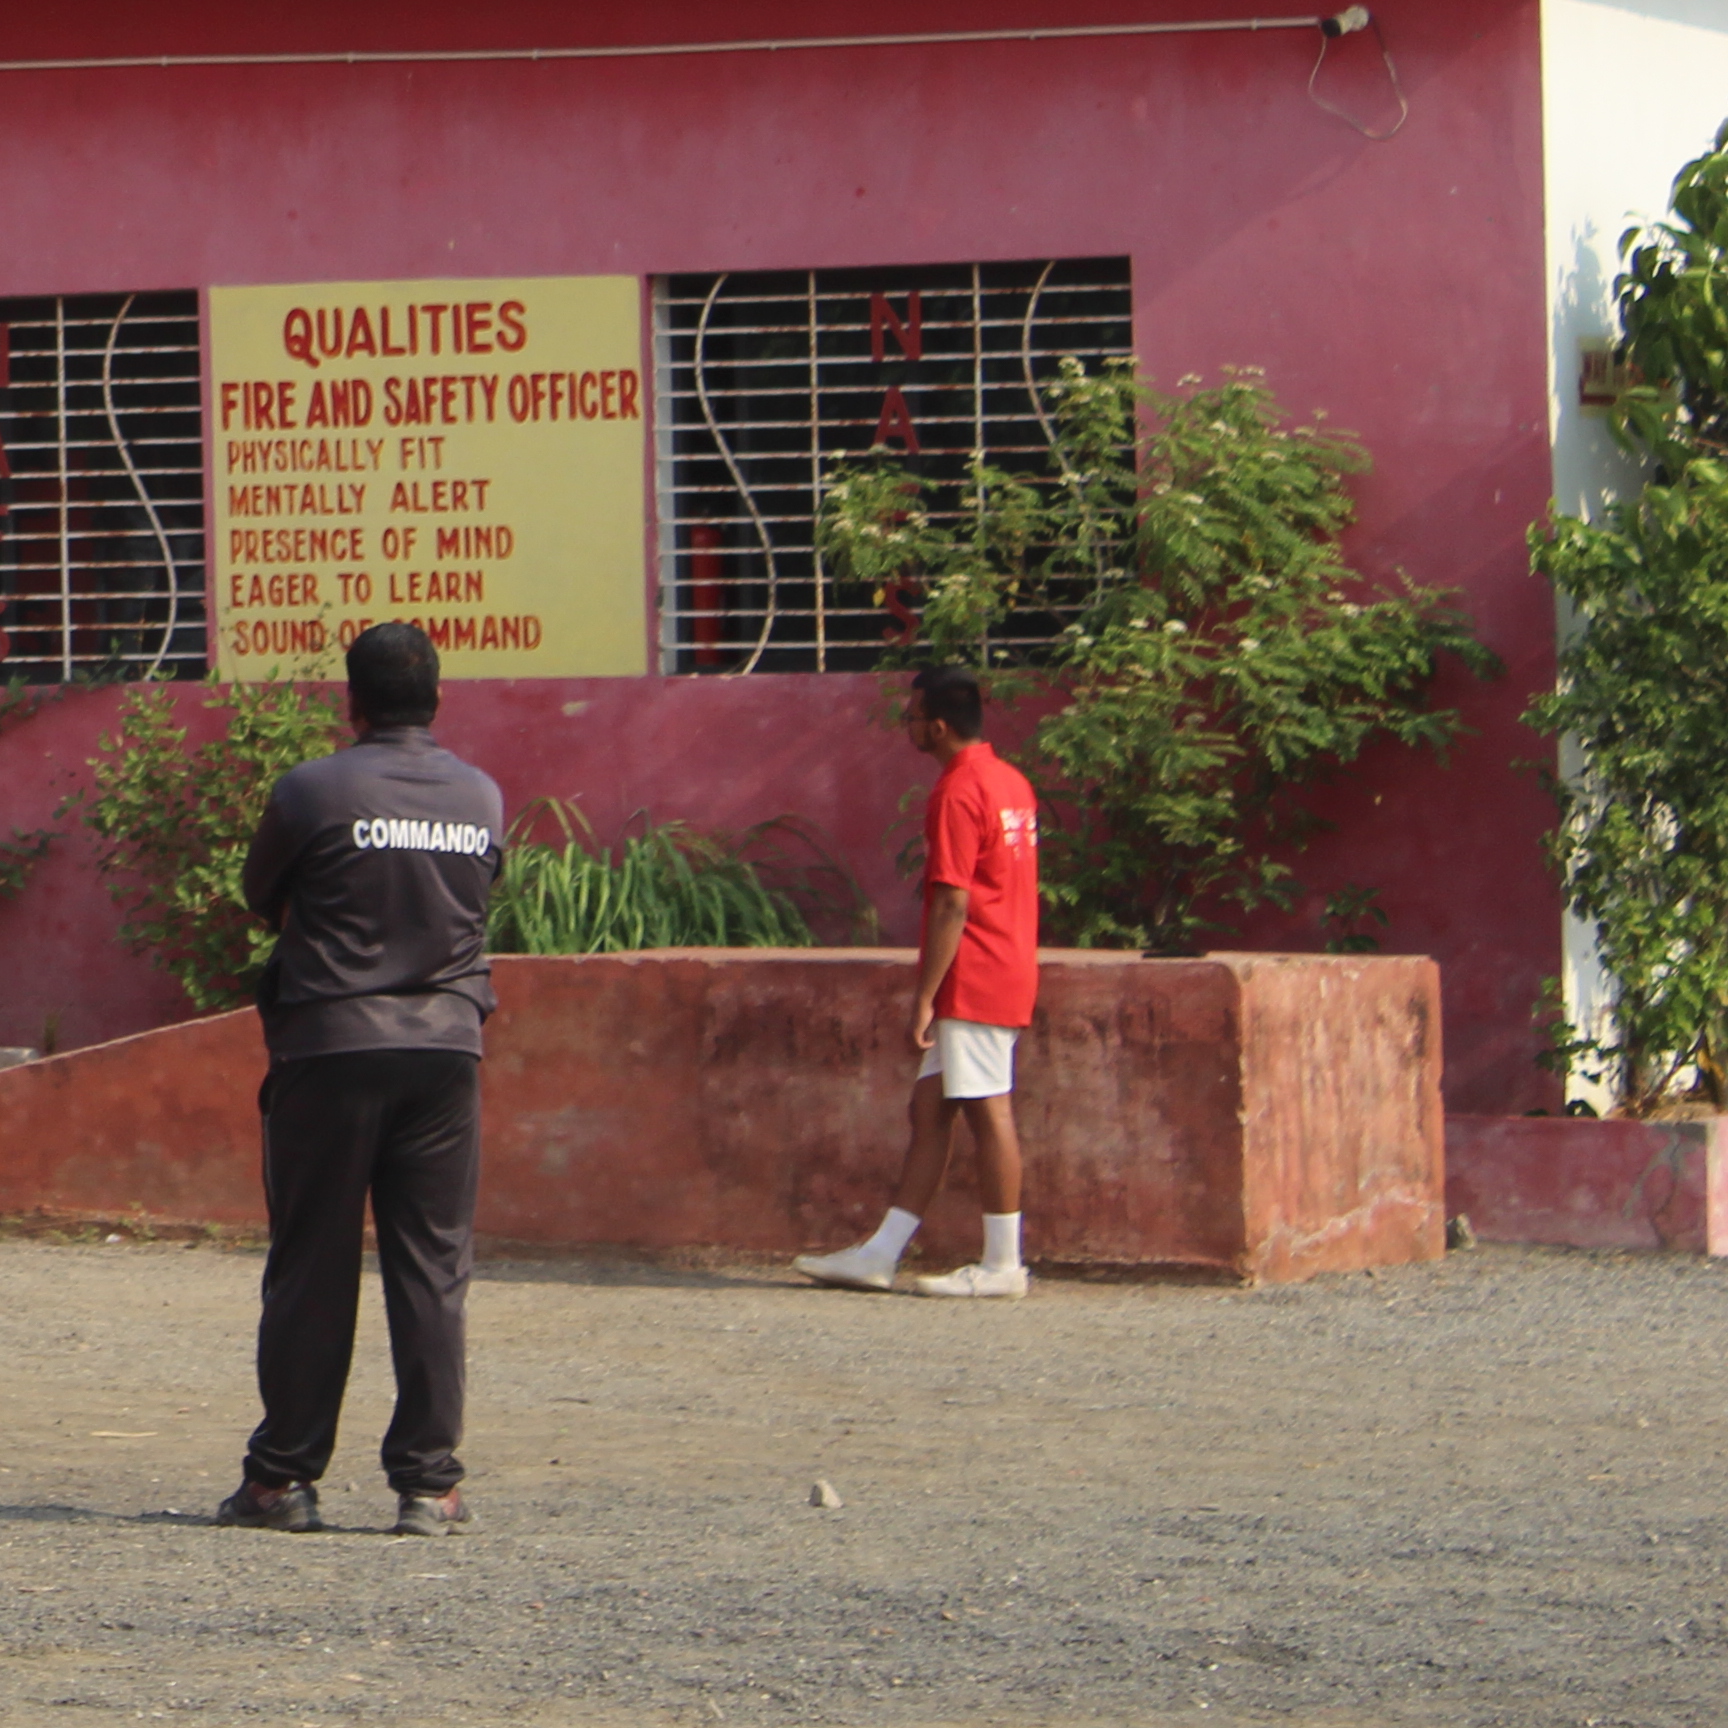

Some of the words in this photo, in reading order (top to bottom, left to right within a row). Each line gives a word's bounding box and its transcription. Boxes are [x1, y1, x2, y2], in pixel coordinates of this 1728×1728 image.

[283, 299, 527, 367] QUALITIES
[221, 380, 297, 431] FIRE
[306, 379, 373, 429] AND
[383, 374, 500, 429] SAFETY
[507, 369, 639, 423] OFFICER
[227, 438, 385, 475] PHYSICALLY
[400, 437, 445, 471] FIT
[228, 483, 366, 517] MENTALLY
[389, 479, 490, 513] ALERT
[229, 529, 364, 565] PRESENCE
[381, 528, 417, 559] OF
[436, 525, 513, 559] MIND
[230, 573, 320, 609] EAGER
[337, 573, 372, 605] TO
[389, 571, 484, 603] LEARN
[233, 620, 327, 656] SOUND
[390, 616, 542, 650] MMAND
[353, 817, 490, 857] COMMANDO
